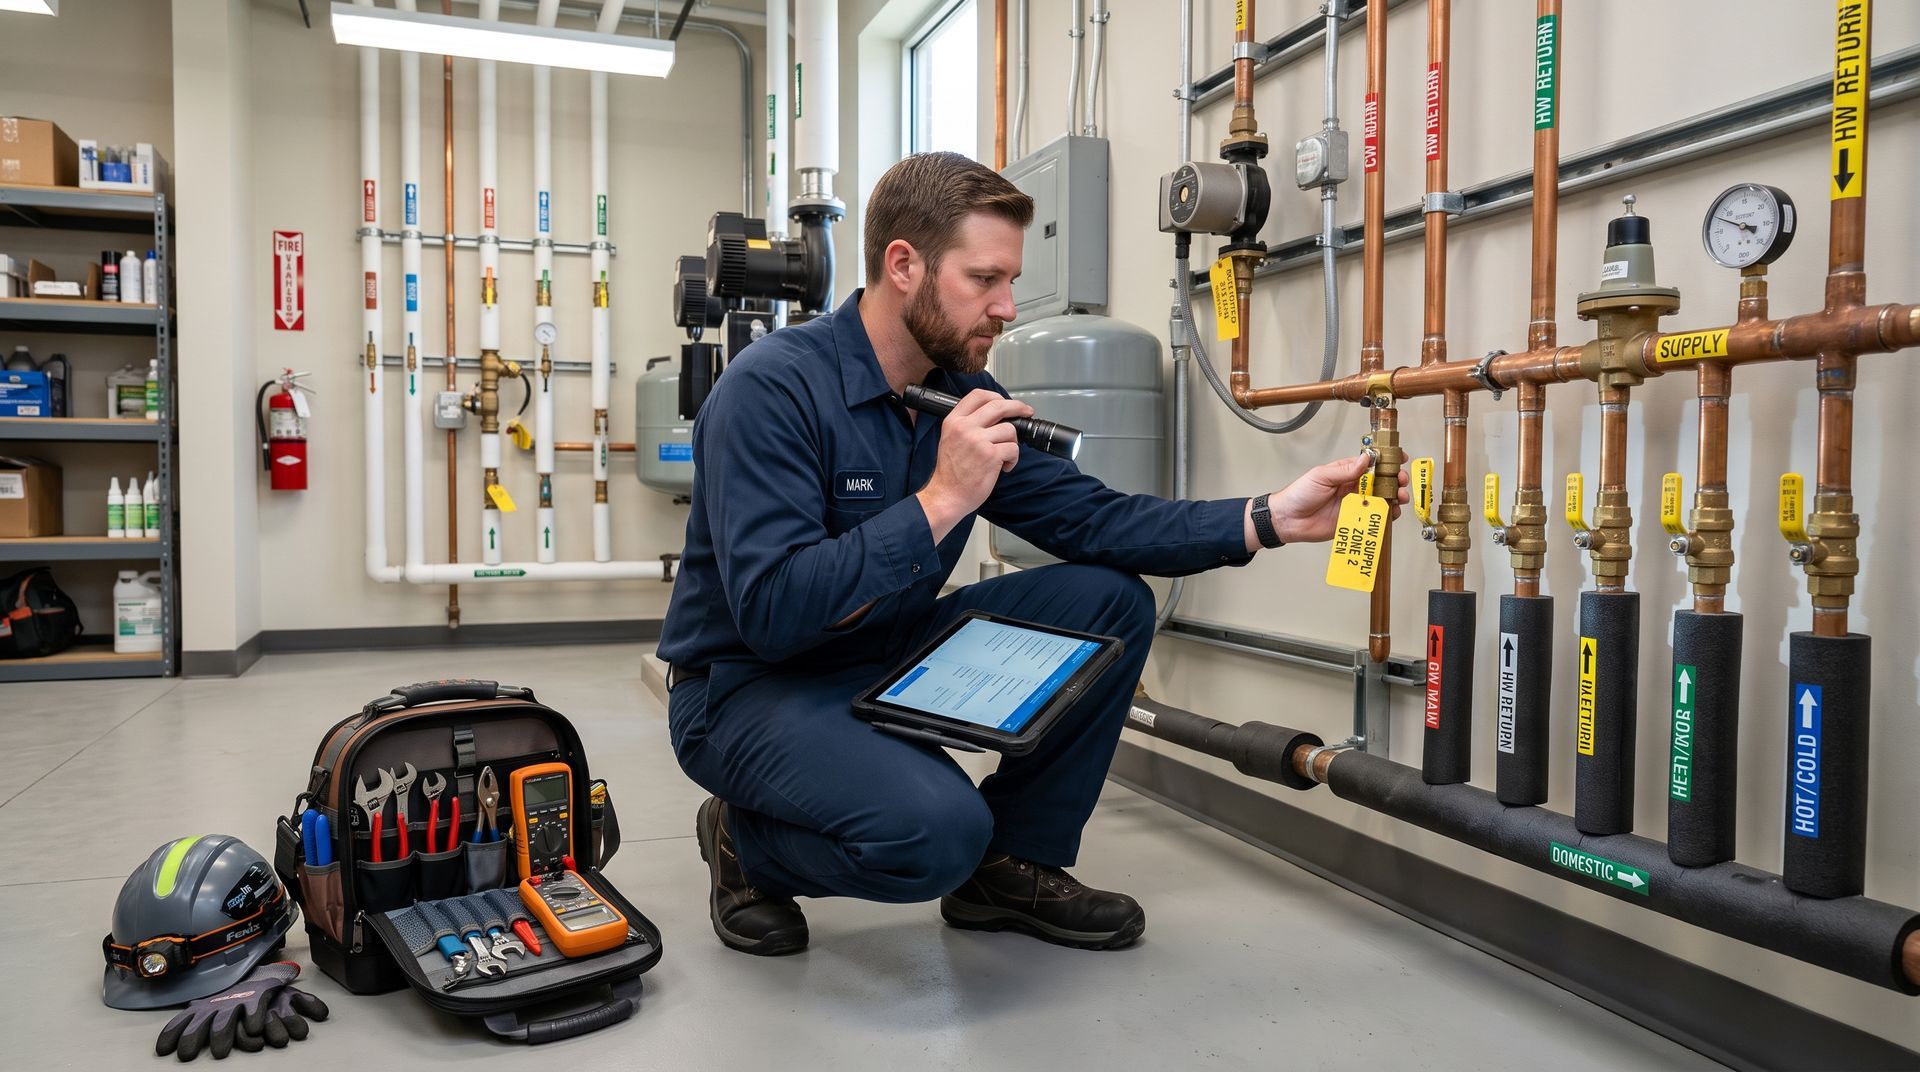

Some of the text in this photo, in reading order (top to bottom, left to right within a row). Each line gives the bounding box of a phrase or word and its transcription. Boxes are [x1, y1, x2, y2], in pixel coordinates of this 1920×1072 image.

[1535, 21, 1554, 125] HW RETURN
[1834, 3, 1863, 143] HW RETURN
[1364, 145, 1377, 169] CW
[1426, 133, 1438, 156] HW
[278, 240, 300, 252] FIRE
[1660, 333, 1723, 359] SUPPLY
[846, 478, 874, 492] MARK
[1334, 526, 1350, 555] OPEN
[1349, 527, 1364, 556] ZONE
[1360, 513, 1382, 578] CHW SUPPLY
[1347, 558, 1359, 566] 2
[1502, 671, 1514, 693] HW
[1795, 734, 1817, 833] HOT/COLD
[1552, 846, 1614, 881] DOMESTIC
